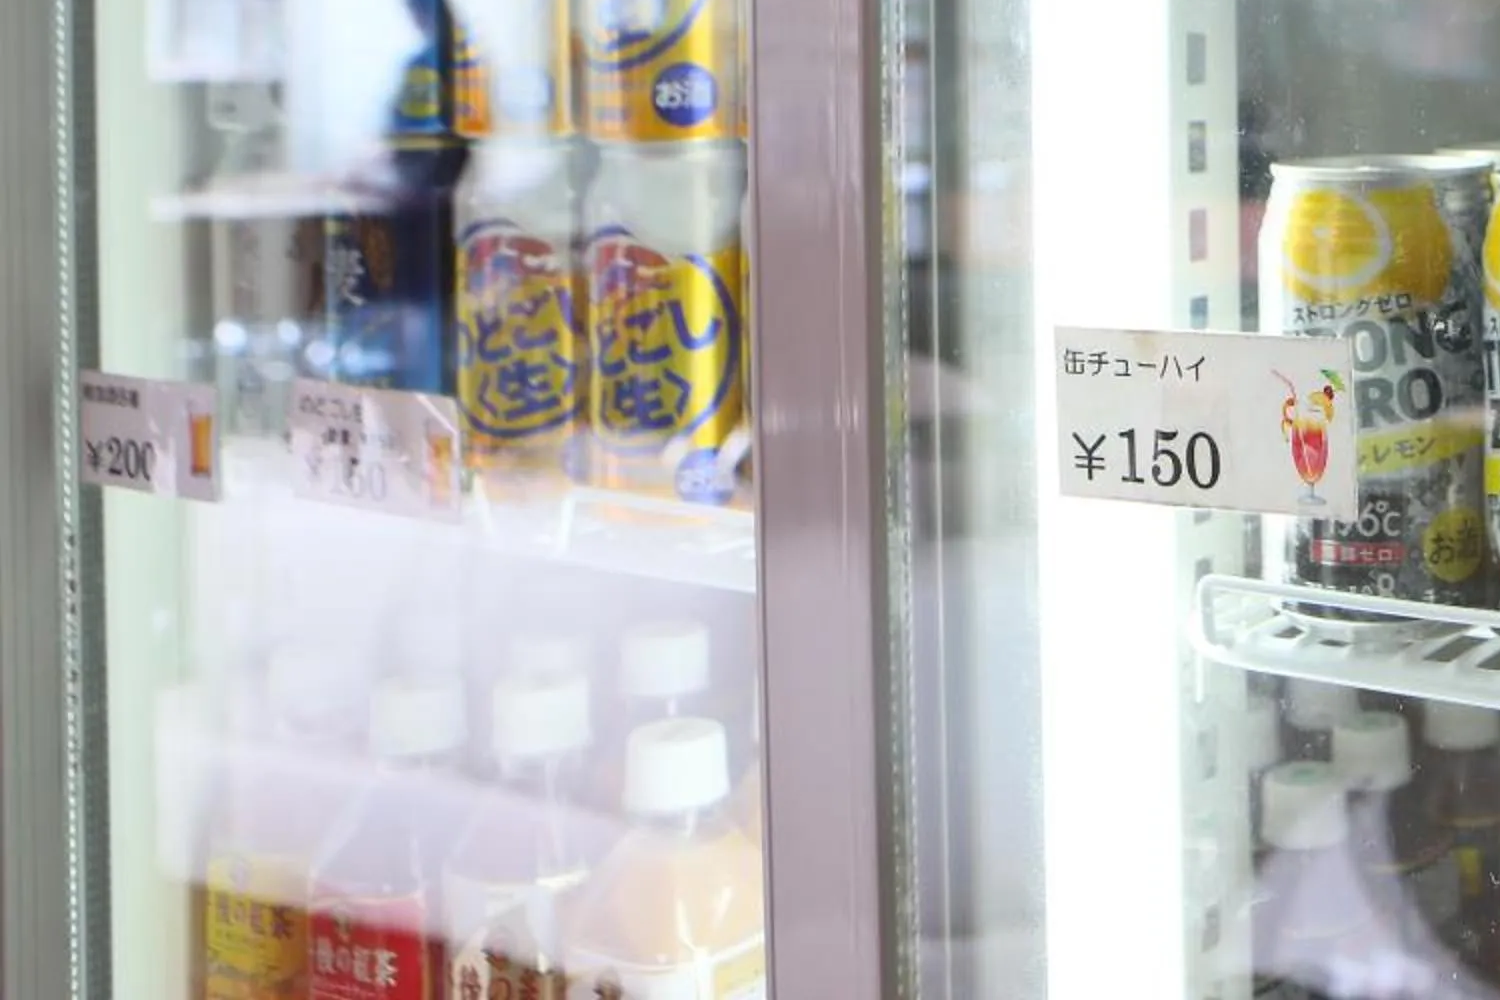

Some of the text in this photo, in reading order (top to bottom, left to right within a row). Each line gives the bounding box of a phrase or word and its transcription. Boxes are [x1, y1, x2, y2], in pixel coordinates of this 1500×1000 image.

[1293, 293, 1413, 323] ストロングゼロ
[1063, 348, 1206, 382] 缶チューハイ
[1354, 367, 1443, 429] RO
[1072, 428, 1221, 490] ¥150
